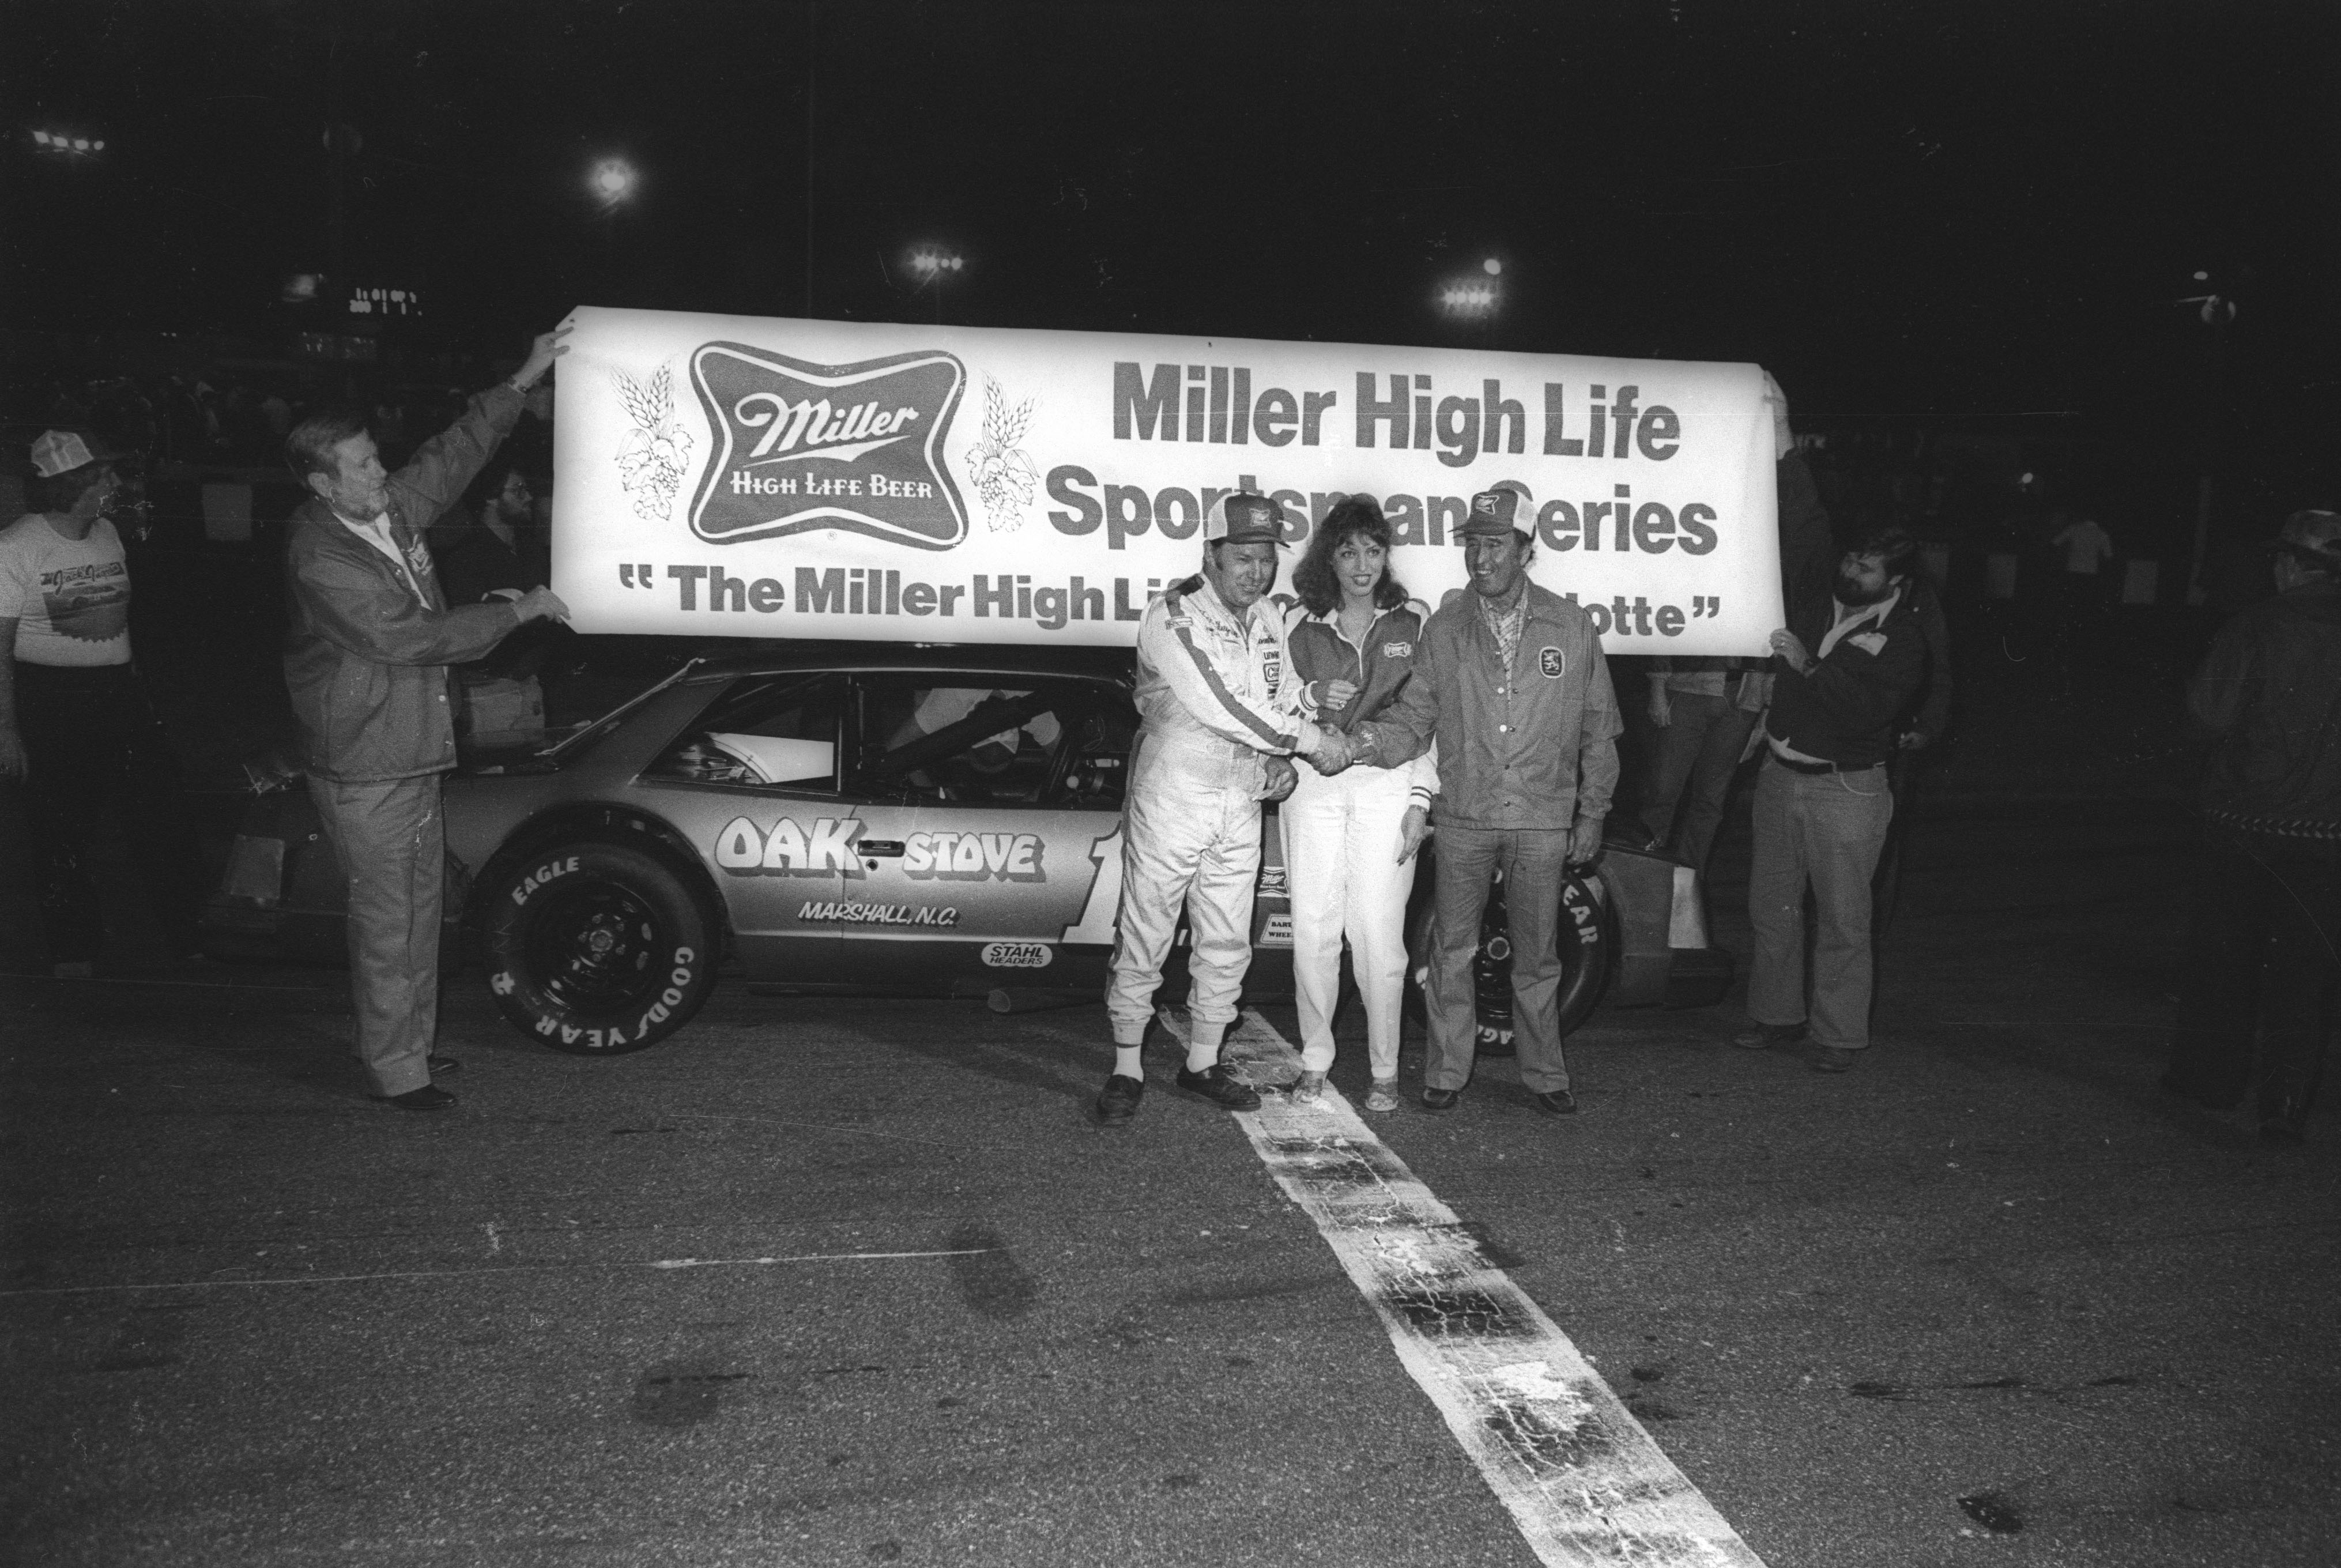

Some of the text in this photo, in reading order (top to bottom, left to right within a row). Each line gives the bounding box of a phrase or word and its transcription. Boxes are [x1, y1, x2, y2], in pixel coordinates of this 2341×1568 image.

[734, 392, 919, 458] Miller
[1113, 361, 1680, 467] Miller High Life
[1489, 479, 1718, 555] eries
[794, 567, 964, 617] Miller
[973, 574, 1104, 630] High
[715, 816, 1042, 877] OAK STOVE
[512, 856, 580, 905] EAGLE
[798, 901, 957, 925] MARSHALL, N.C.
[990, 946, 1043, 958] STAHL
[990, 957, 1043, 965] HEADERS
